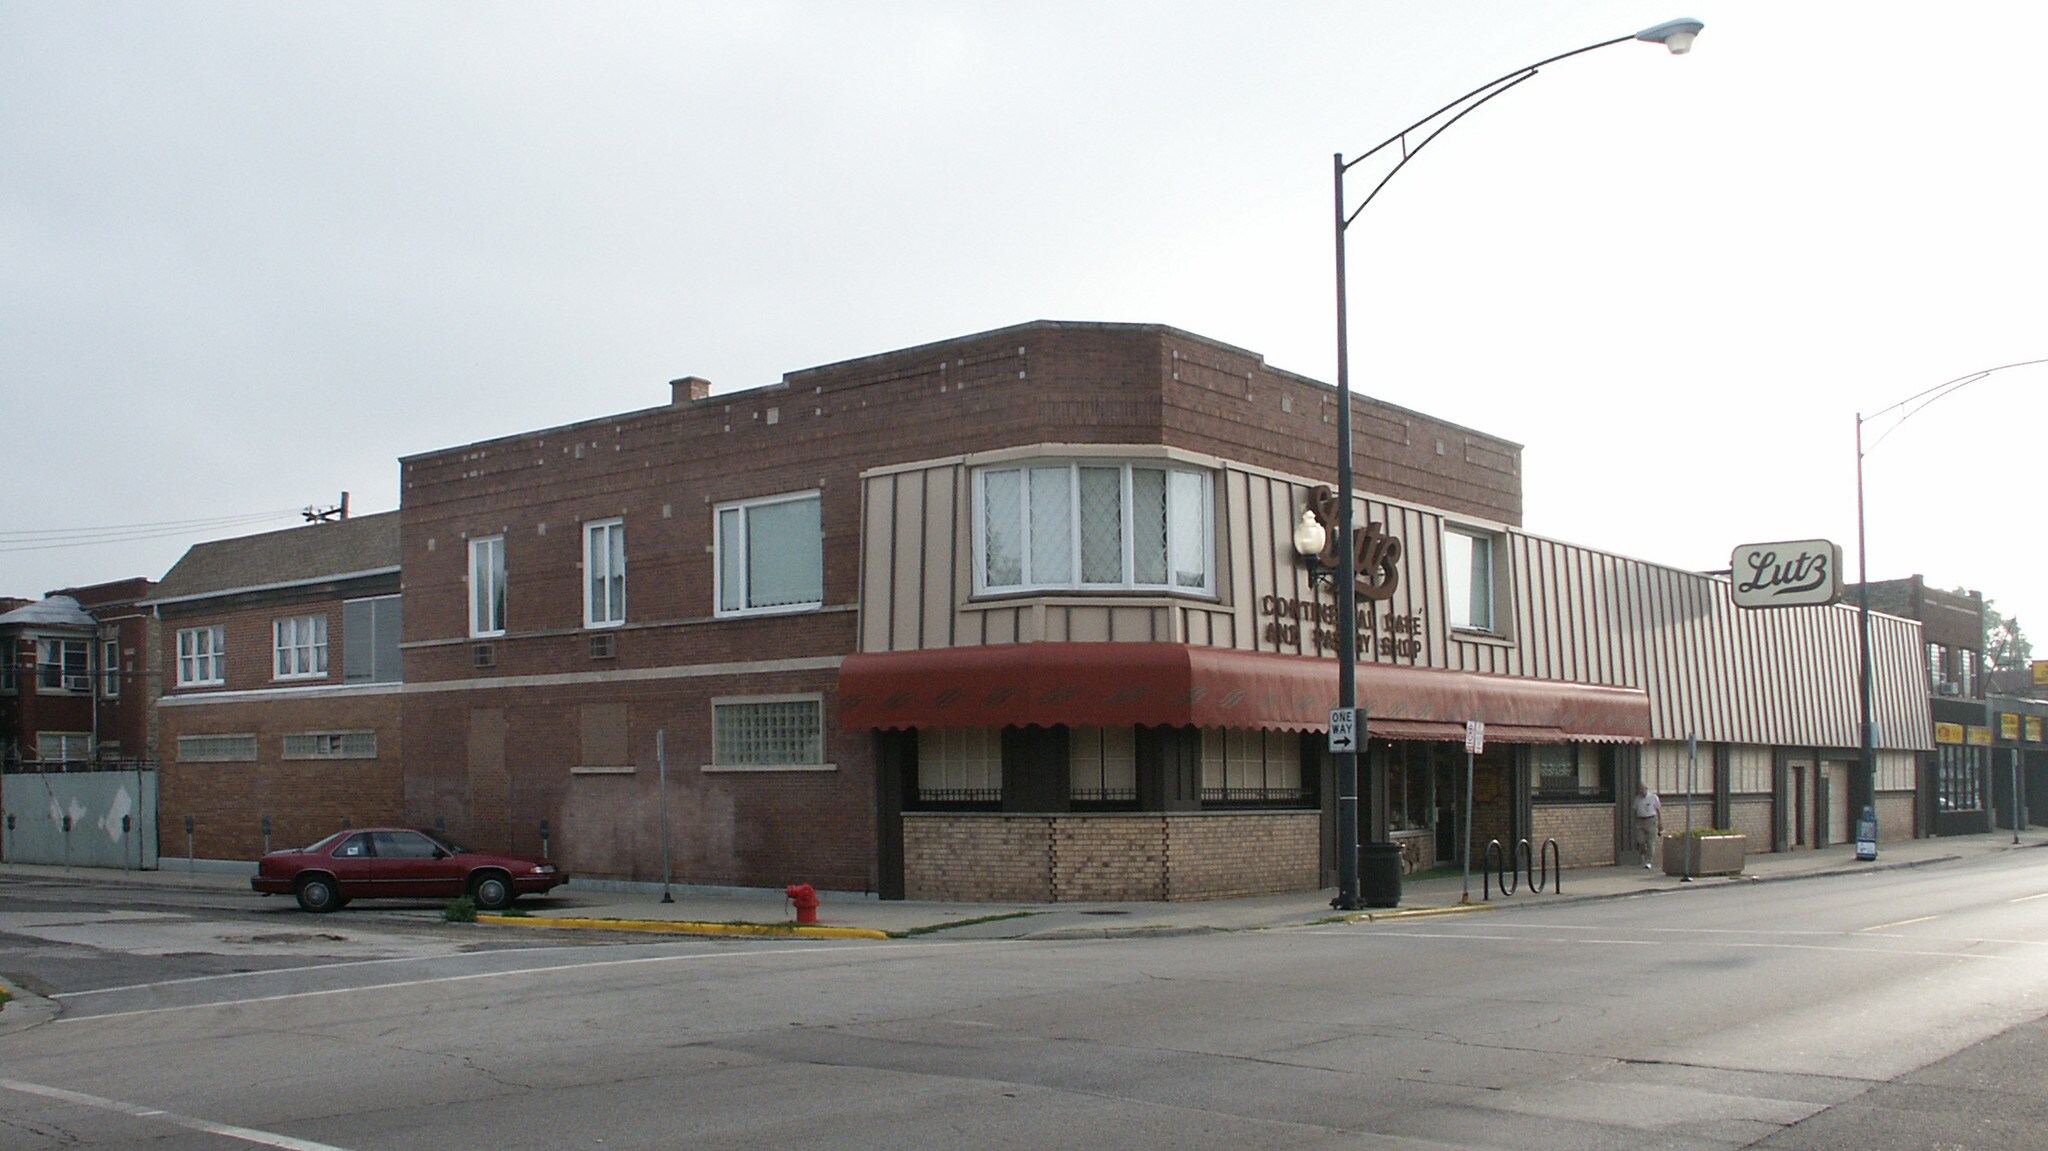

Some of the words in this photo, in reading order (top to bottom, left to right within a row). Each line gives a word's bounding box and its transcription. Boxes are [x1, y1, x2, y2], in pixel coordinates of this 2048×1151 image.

[1738, 551, 1827, 596] Lutz
[1263, 595, 1373, 630] CONTINEAL
[1265, 623, 1300, 646] AND
[1313, 627, 1371, 654] PASRY
[1381, 637, 1422, 659] SHOP
[1332, 711, 1352, 723] ONE
[1332, 723, 1352, 735] WAY
